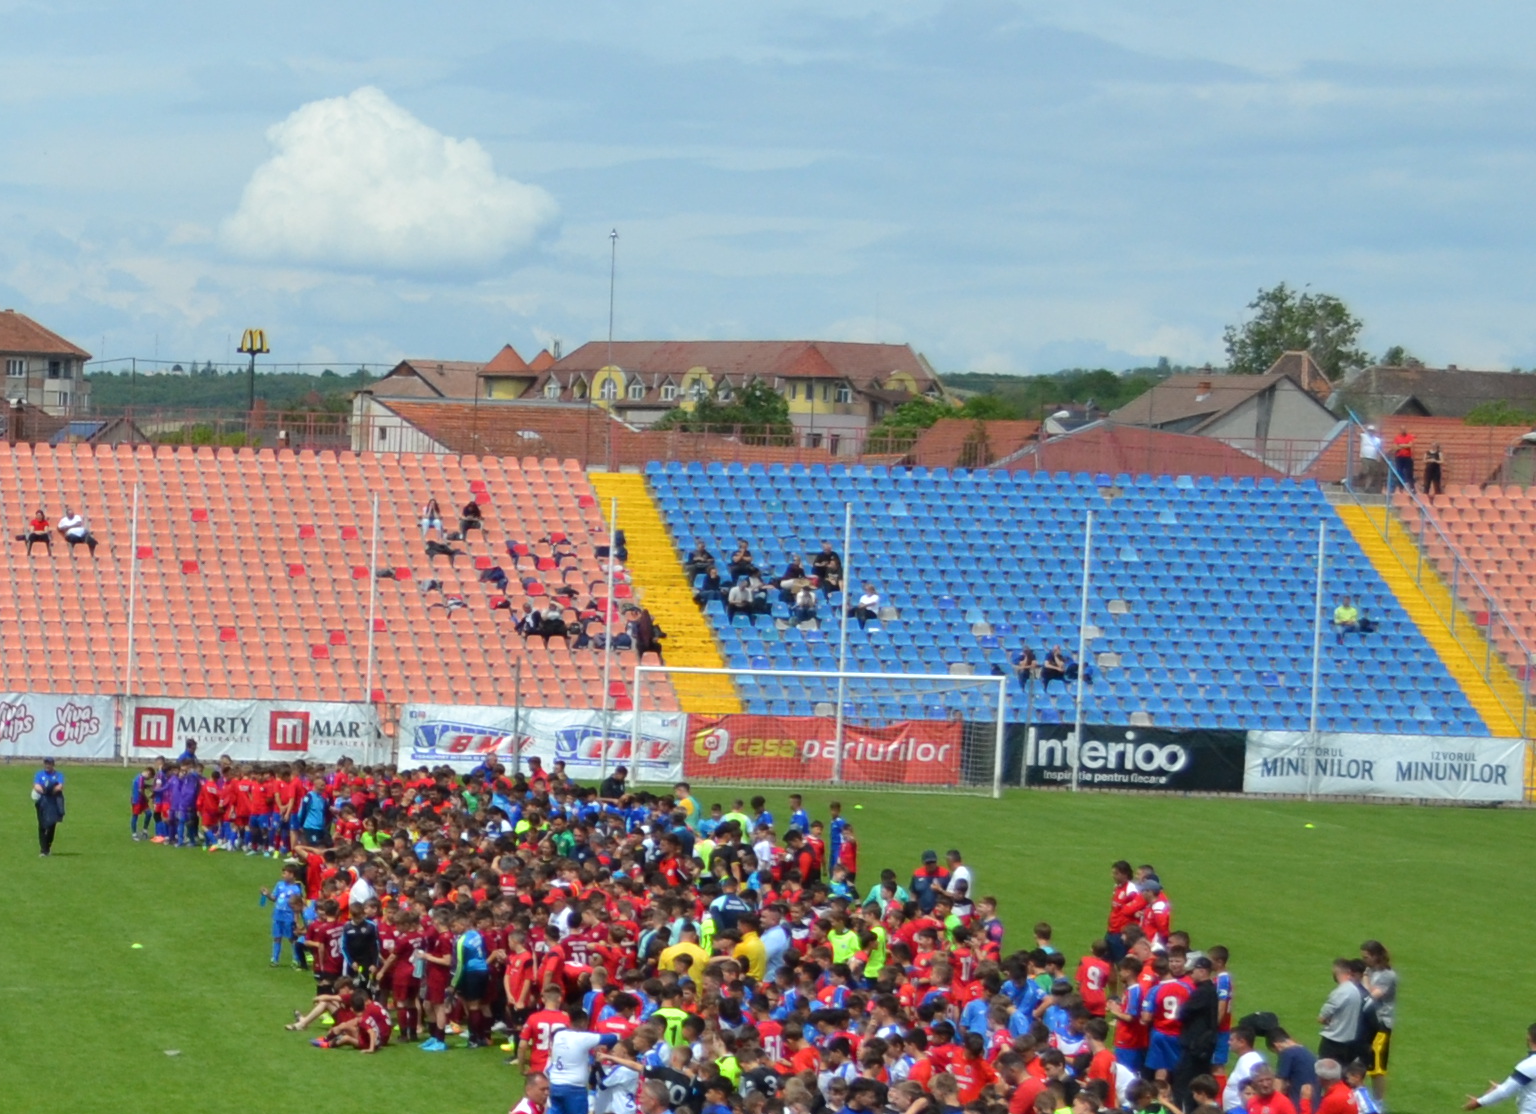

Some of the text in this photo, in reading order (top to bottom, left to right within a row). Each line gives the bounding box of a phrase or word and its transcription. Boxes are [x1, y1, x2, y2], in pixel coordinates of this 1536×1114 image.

[57, 703, 92, 724] Viva
[178, 716, 253, 734] MARTY
[49, 717, 100, 746] Chips
[733, 738, 952, 763] casa pariurilor
[1027, 727, 1186, 772] Interioo
[1431, 752, 1477, 761] IZVORUL
[1094, 773, 1128, 783] pentru
[1130, 773, 1168, 784] fiecare
[1396, 761, 1508, 785] MINUNILOR
[1087, 965, 1101, 990] 9
[1163, 995, 1178, 1020] 9
[669, 1025, 679, 1047] 1
[764, 1075, 778, 1096] 3
